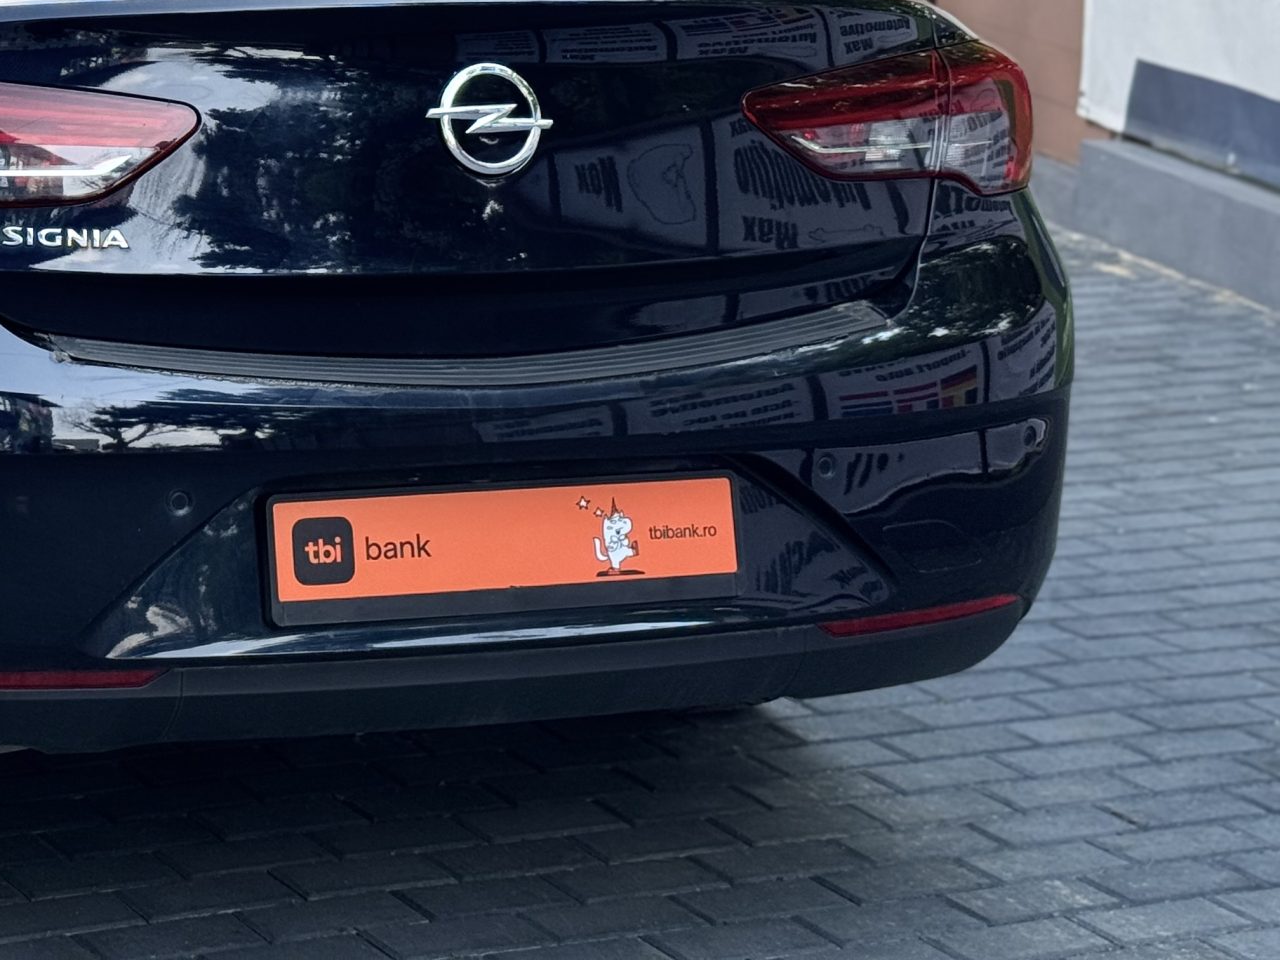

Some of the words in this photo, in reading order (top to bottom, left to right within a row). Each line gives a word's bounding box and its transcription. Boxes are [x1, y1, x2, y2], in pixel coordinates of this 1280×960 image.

[648, 524, 717, 540] tbibank.ro
[304, 536, 343, 564] tbi
[365, 533, 432, 560] bank
